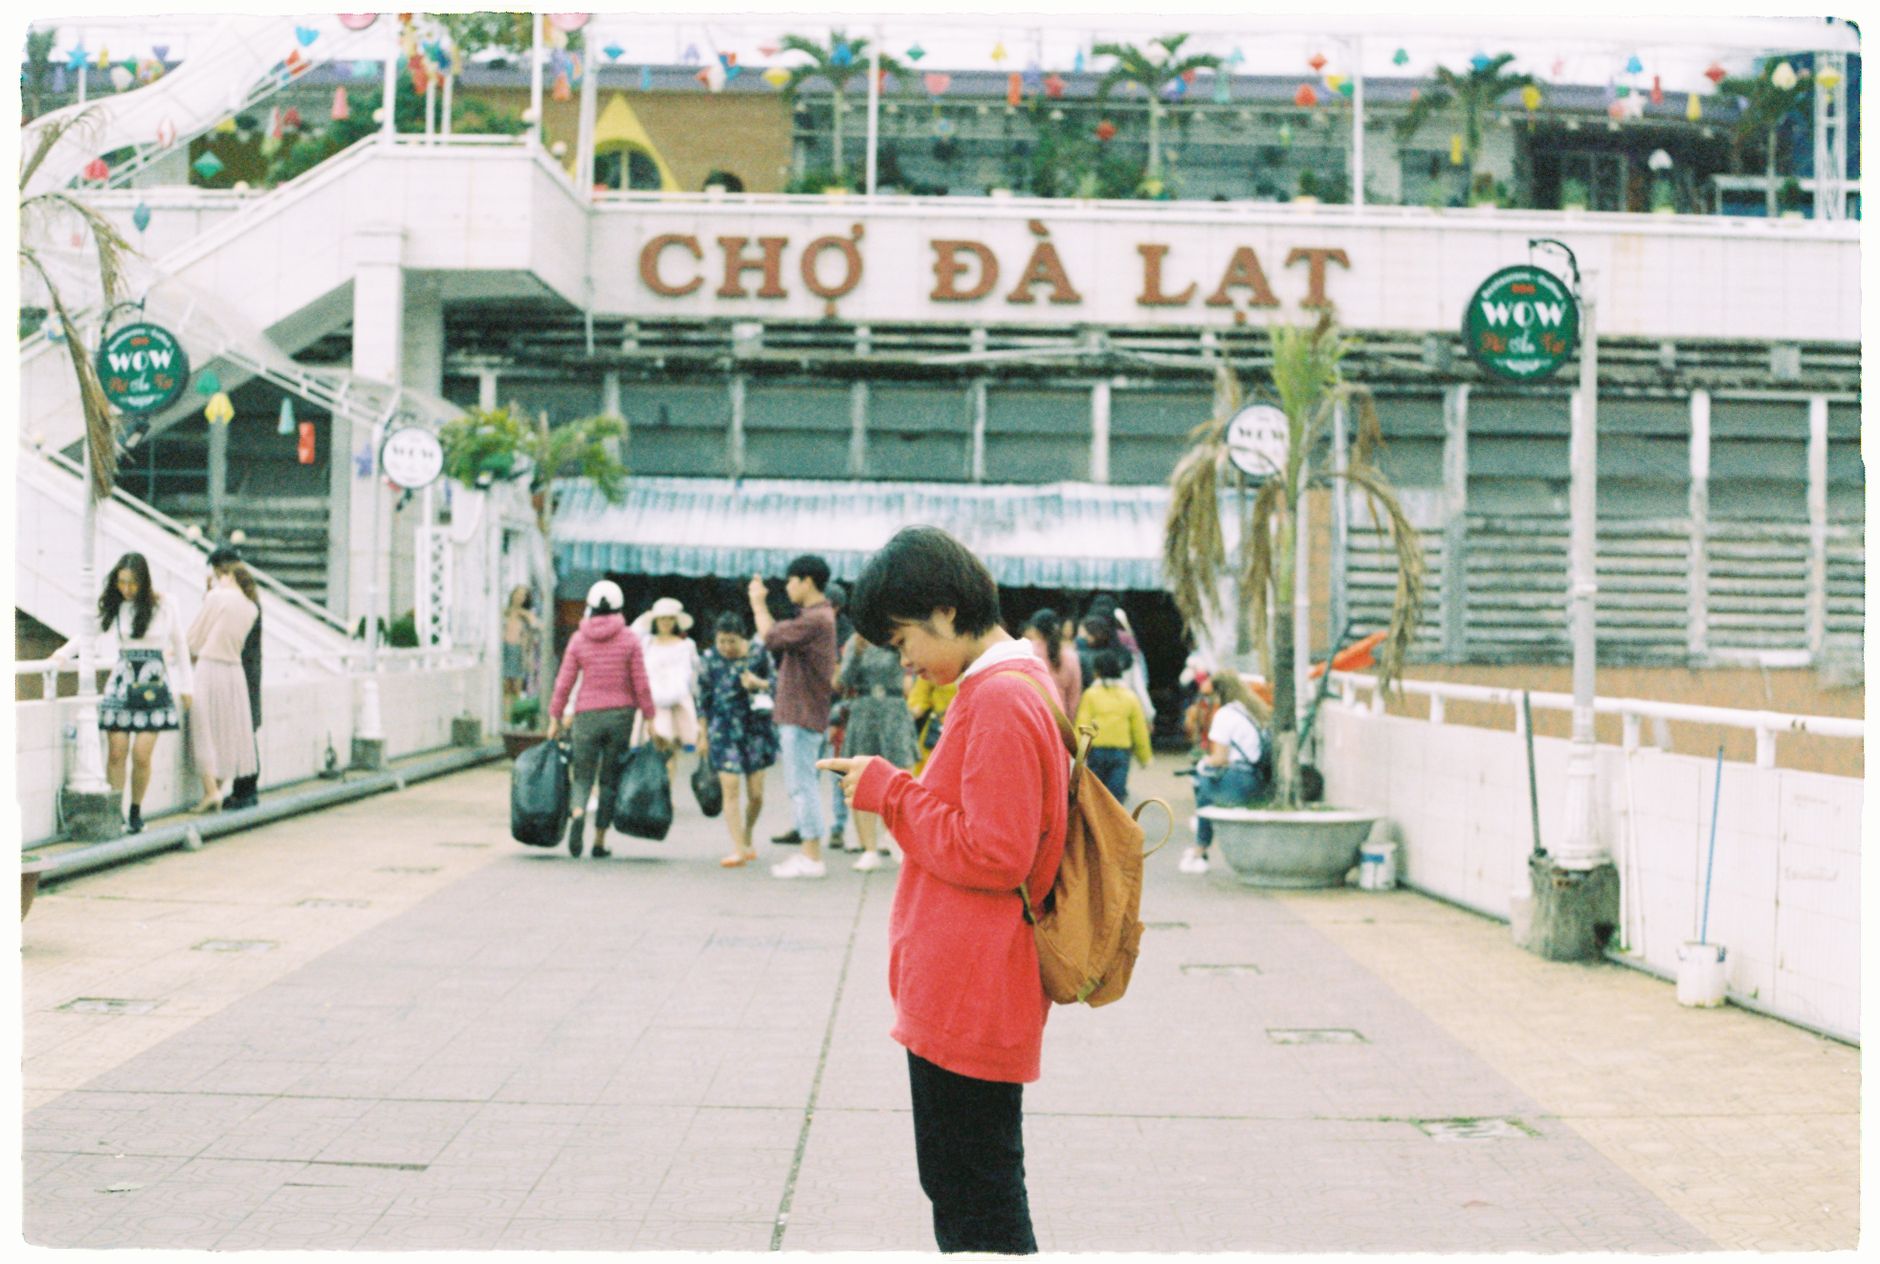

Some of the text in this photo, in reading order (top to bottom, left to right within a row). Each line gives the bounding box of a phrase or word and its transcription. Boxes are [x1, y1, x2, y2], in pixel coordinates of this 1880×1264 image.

[638, 219, 1351, 324] CHỢ ĐÀ LẠT
[1481, 301, 1567, 327] WOW
[107, 348, 175, 373] WOW
